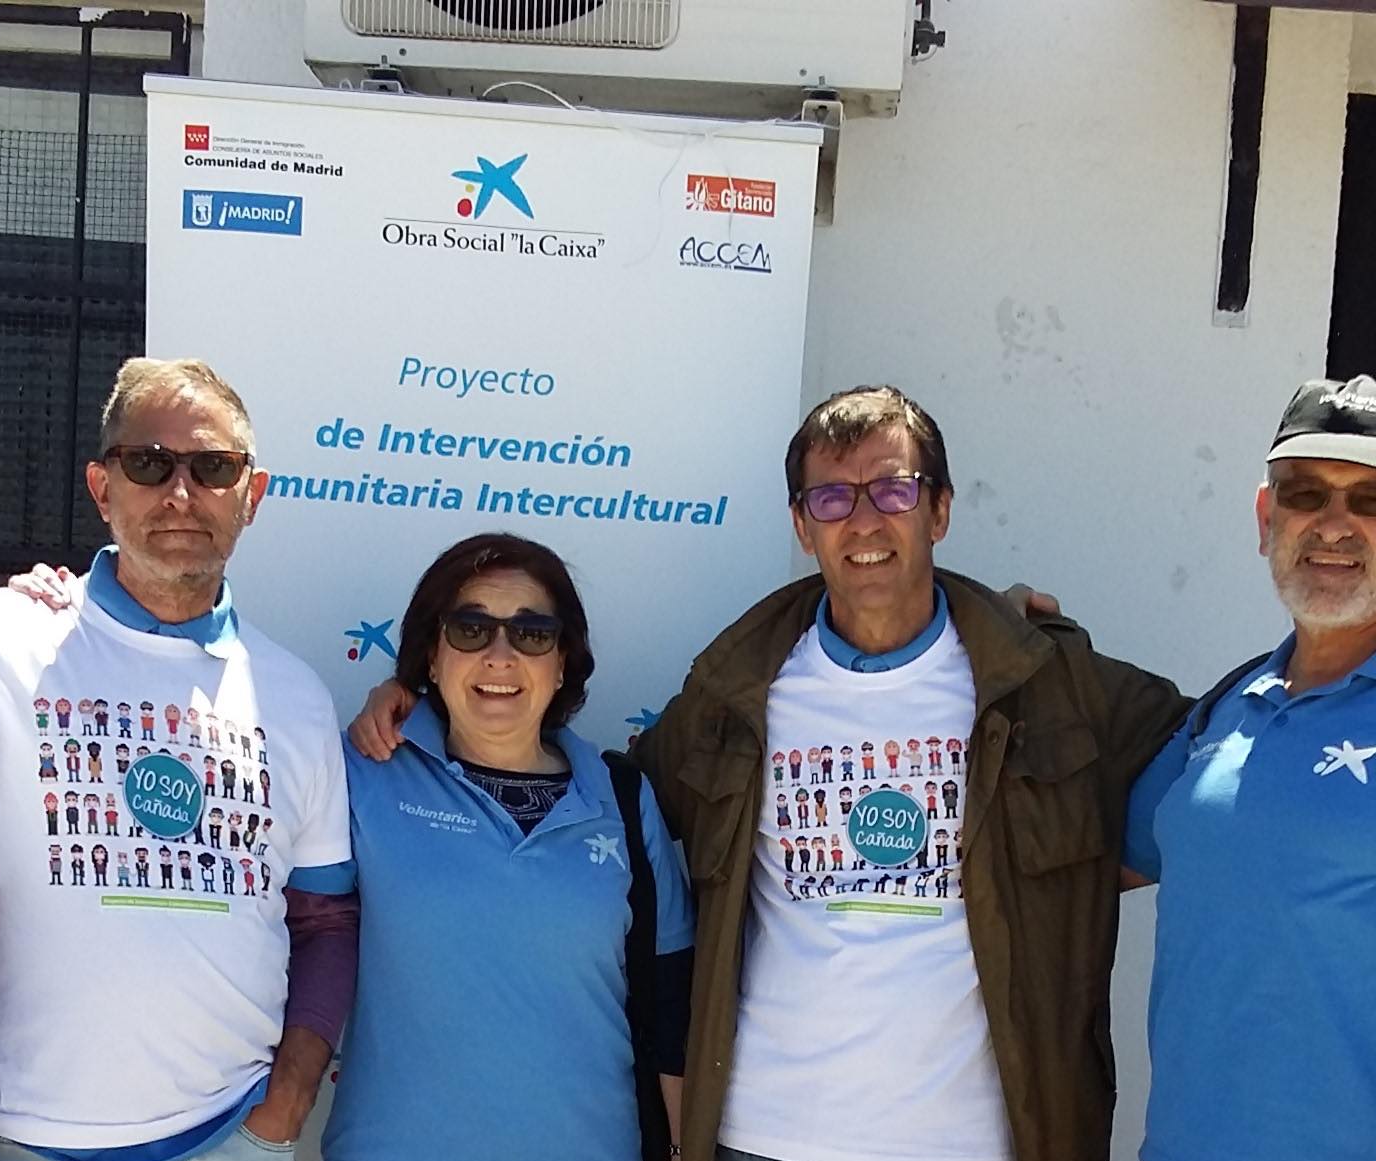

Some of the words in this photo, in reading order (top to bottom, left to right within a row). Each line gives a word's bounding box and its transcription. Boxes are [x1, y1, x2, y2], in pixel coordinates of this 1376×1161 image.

[184, 154, 266, 170] Comunidad
[270, 160, 289, 172] de
[293, 161, 343, 177] Madrid
[218, 199, 296, 227] ¡MADRID!
[720, 188, 773, 213] Gitano
[382, 223, 437, 248] Obra
[443, 227, 505, 253] Social
[398, 355, 555, 398] Proyecto
[315, 417, 364, 450] de
[377, 423, 632, 468] Intervención
[265, 471, 464, 511] munitaria
[475, 482, 729, 526] Intercultural
[132, 767, 157, 792] YO
[158, 777, 198, 804] SOY
[132, 794, 192, 825] Cañada
[399, 801, 478, 827] Voluntarios
[855, 805, 880, 827] YO
[881, 807, 920, 831] SOY
[854, 830, 917, 851] Cañada
